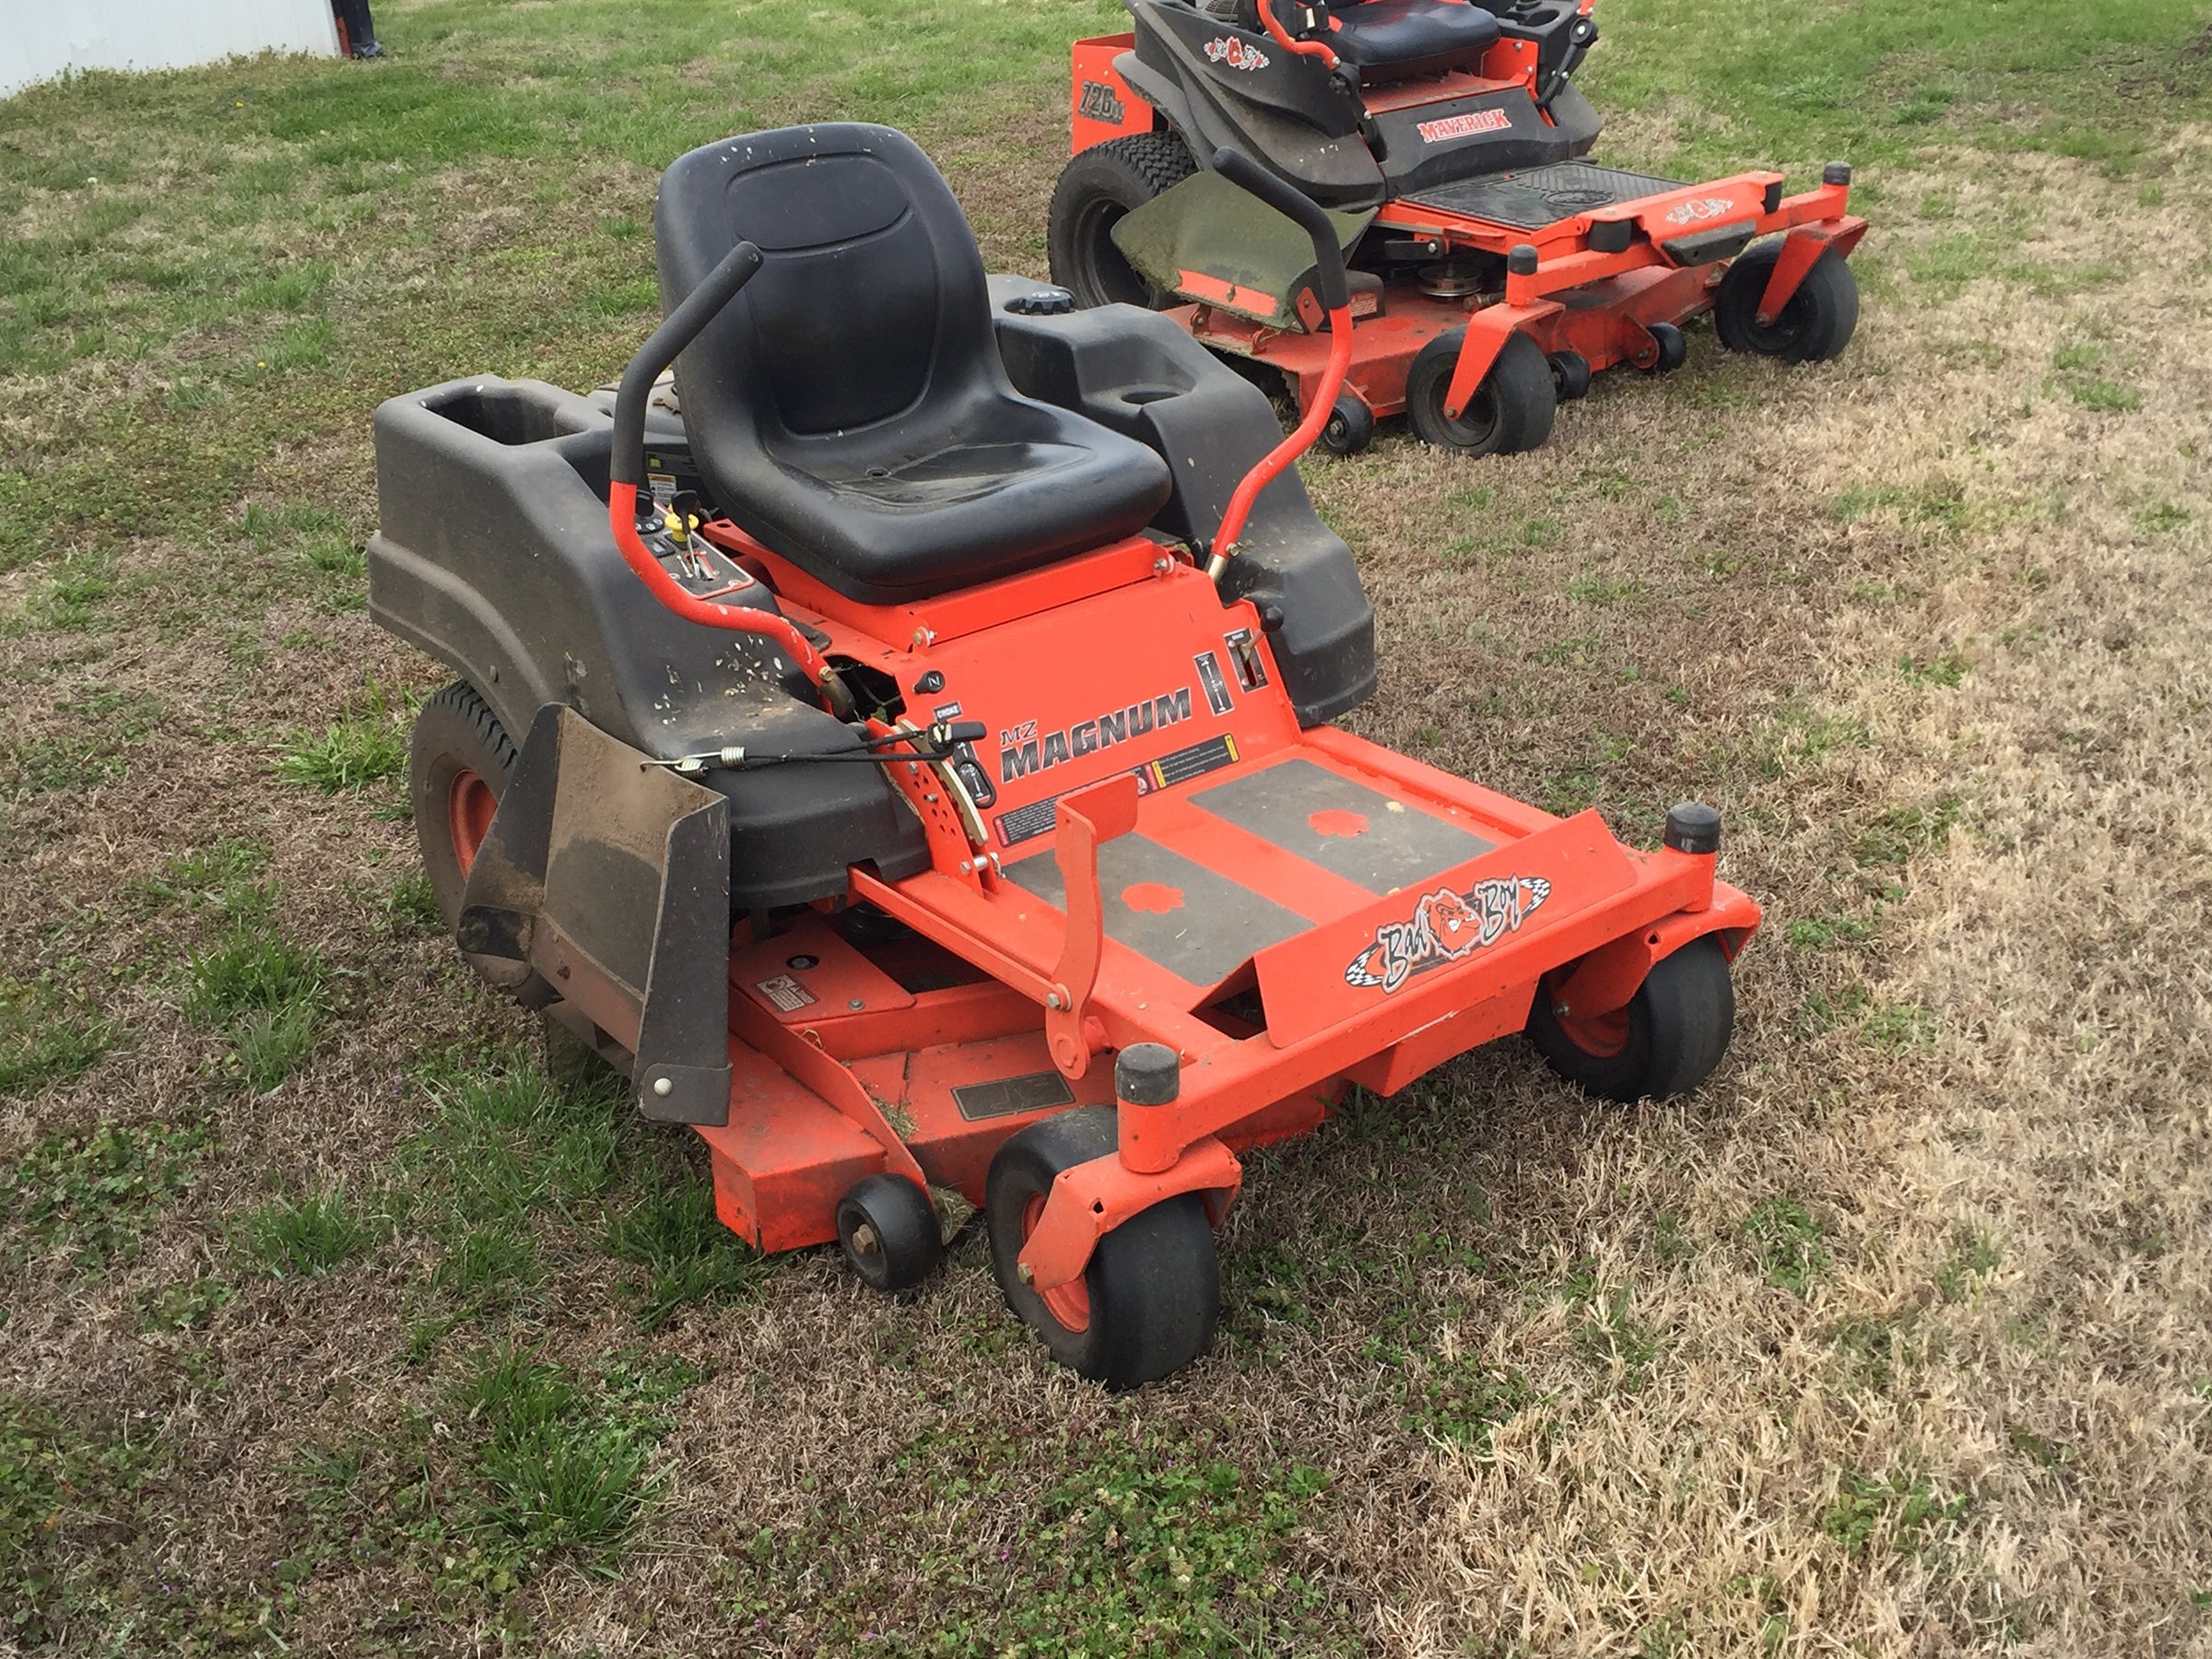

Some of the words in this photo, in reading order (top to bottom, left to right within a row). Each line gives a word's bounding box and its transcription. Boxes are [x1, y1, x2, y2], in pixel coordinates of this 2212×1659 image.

[1418, 109, 1512, 142] MAVERICK
[927, 675, 941, 688] N
[936, 704, 960, 719] CHOKE
[1000, 719, 1038, 747] MZ
[1001, 687, 1192, 783] MAGNUM
[1379, 908, 1430, 991] Bad
[1477, 877, 1521, 943] Boy
